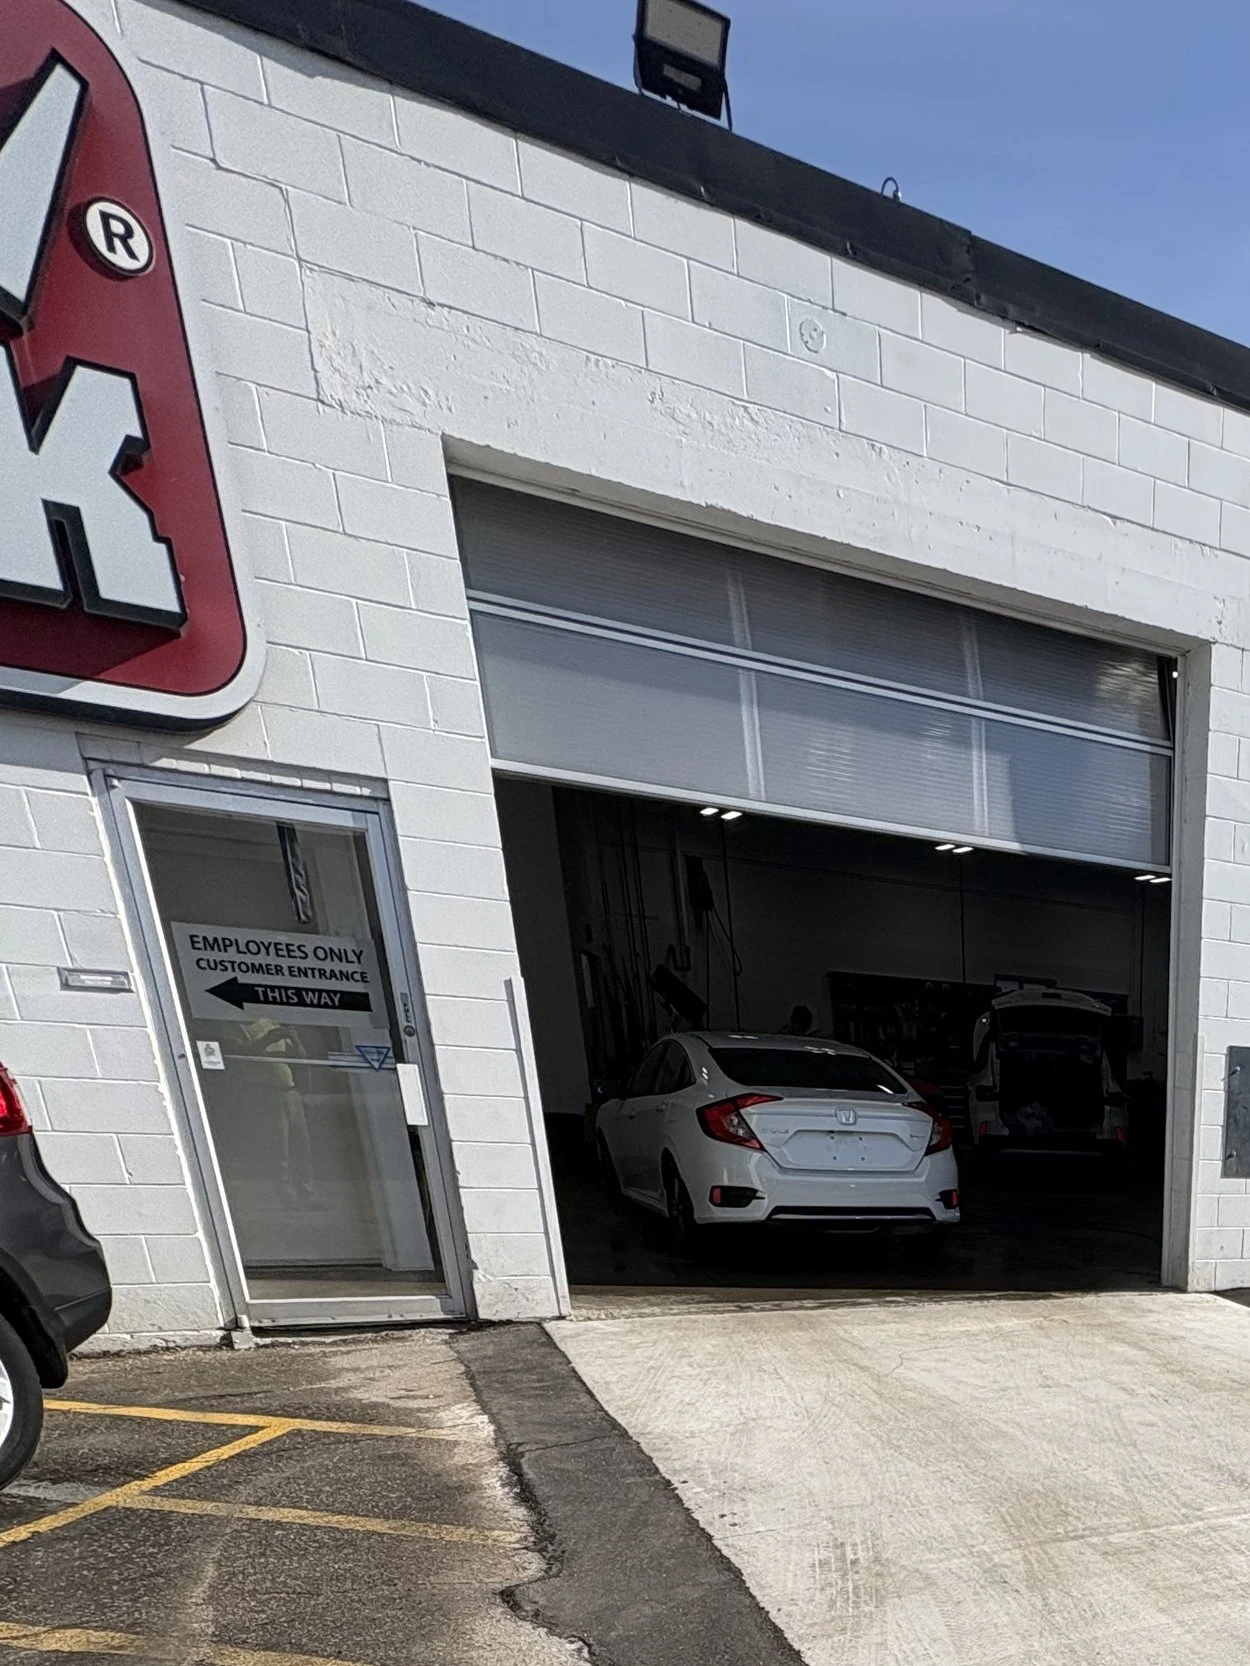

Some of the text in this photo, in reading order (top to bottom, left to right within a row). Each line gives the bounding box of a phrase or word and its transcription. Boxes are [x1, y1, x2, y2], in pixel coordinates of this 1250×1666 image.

[189, 934, 364, 965] EMPLOYEES ONLY
[195, 958, 370, 984] CUSTOMER ENTRANCE
[254, 986, 341, 1006] THIS WAY
